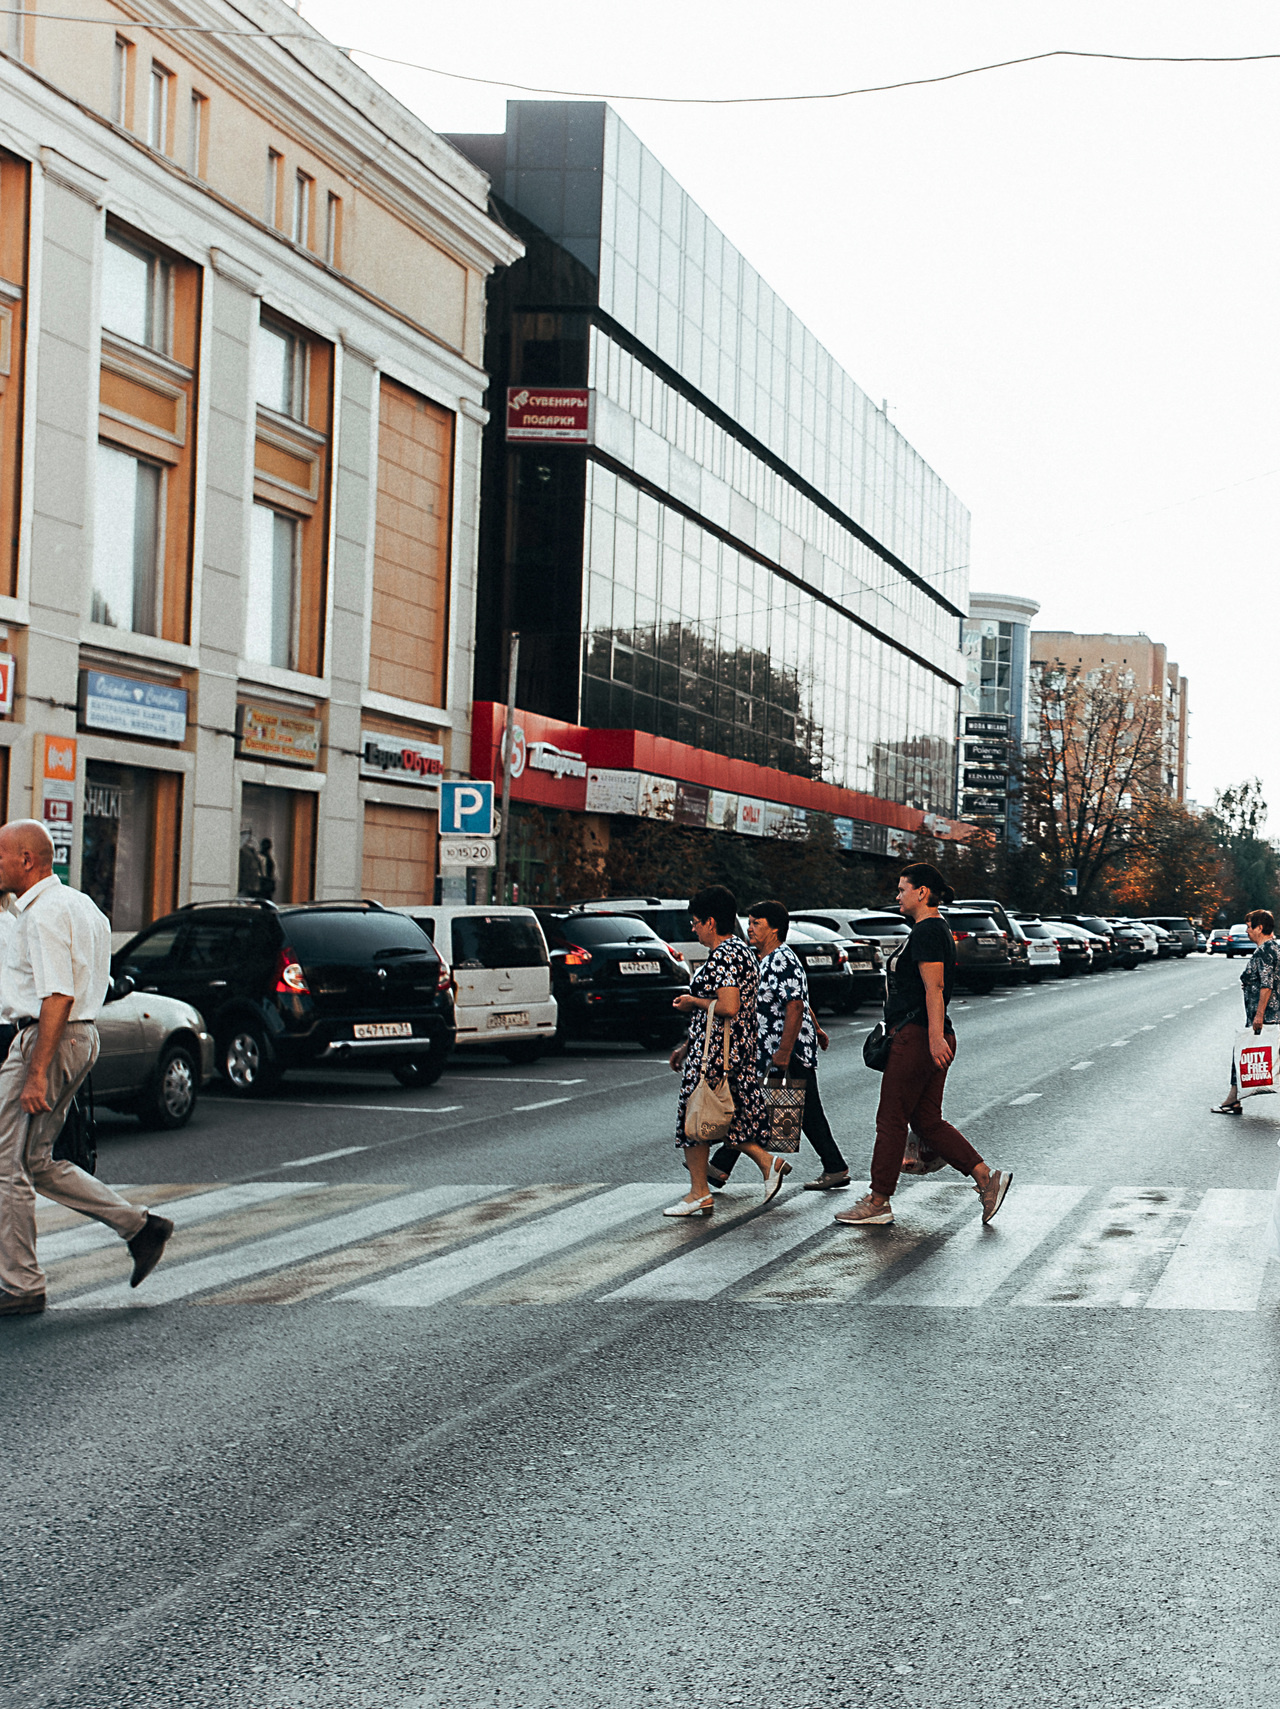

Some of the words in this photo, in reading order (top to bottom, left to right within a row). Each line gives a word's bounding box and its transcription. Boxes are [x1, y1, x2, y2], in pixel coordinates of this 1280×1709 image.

[529, 396, 588, 408] СУВЕНИРЫ
[523, 414, 576, 426] ПОДАРКИ
[972, 745, 1002, 755] Palermo
[365, 742, 445, 776] ЕвроОбувь
[454, 787, 484, 829] P
[458, 848, 469, 857] 15
[472, 846, 488, 858] 20
[1241, 1052, 1265, 1064] DUTY
[1248, 1062, 1269, 1074] FREE
